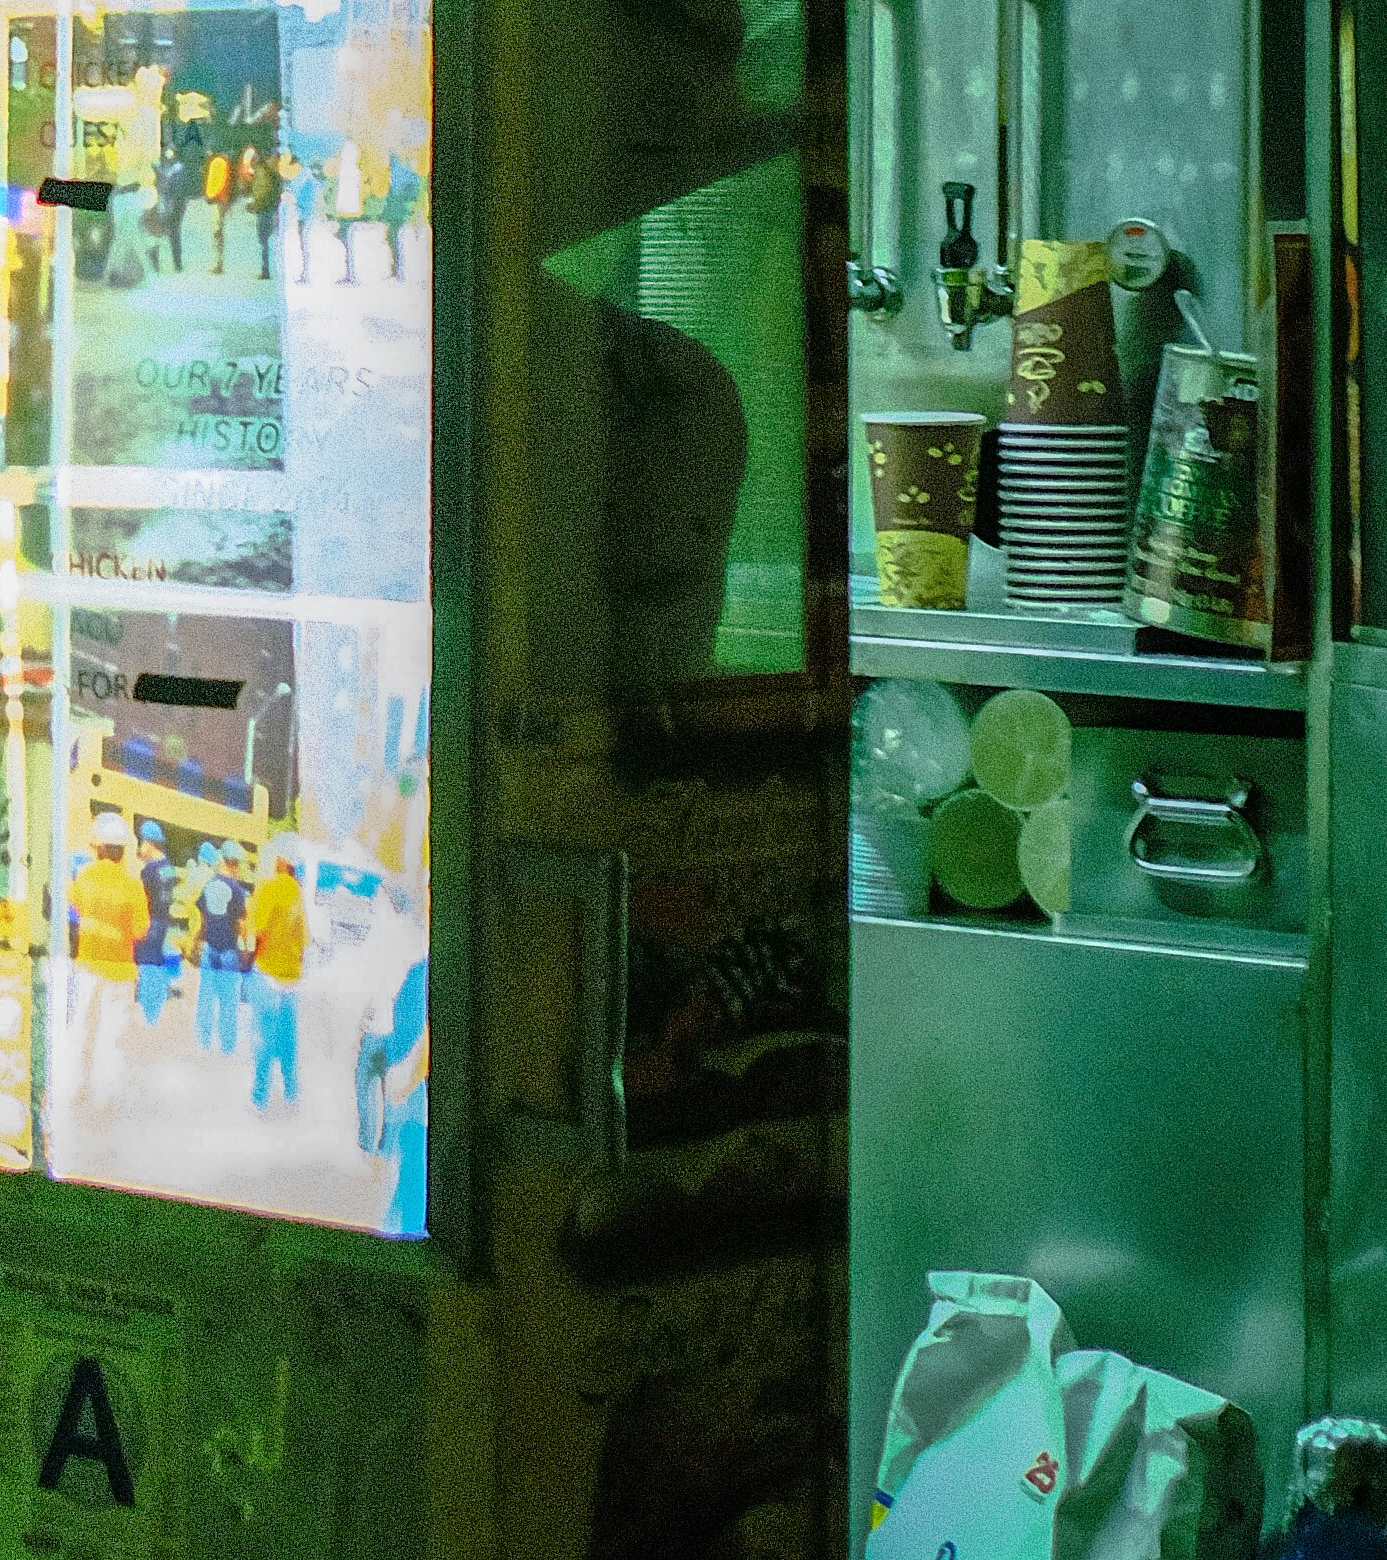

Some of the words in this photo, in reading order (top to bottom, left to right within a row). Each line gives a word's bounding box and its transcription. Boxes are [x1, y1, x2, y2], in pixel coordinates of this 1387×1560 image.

[135, 356, 211, 390] OUR
[225, 361, 239, 392] 7
[253, 362, 375, 399] YEARS
[175, 418, 330, 455] HISTOY
[76, 669, 130, 701] FOR
[38, 1355, 137, 1508] A
